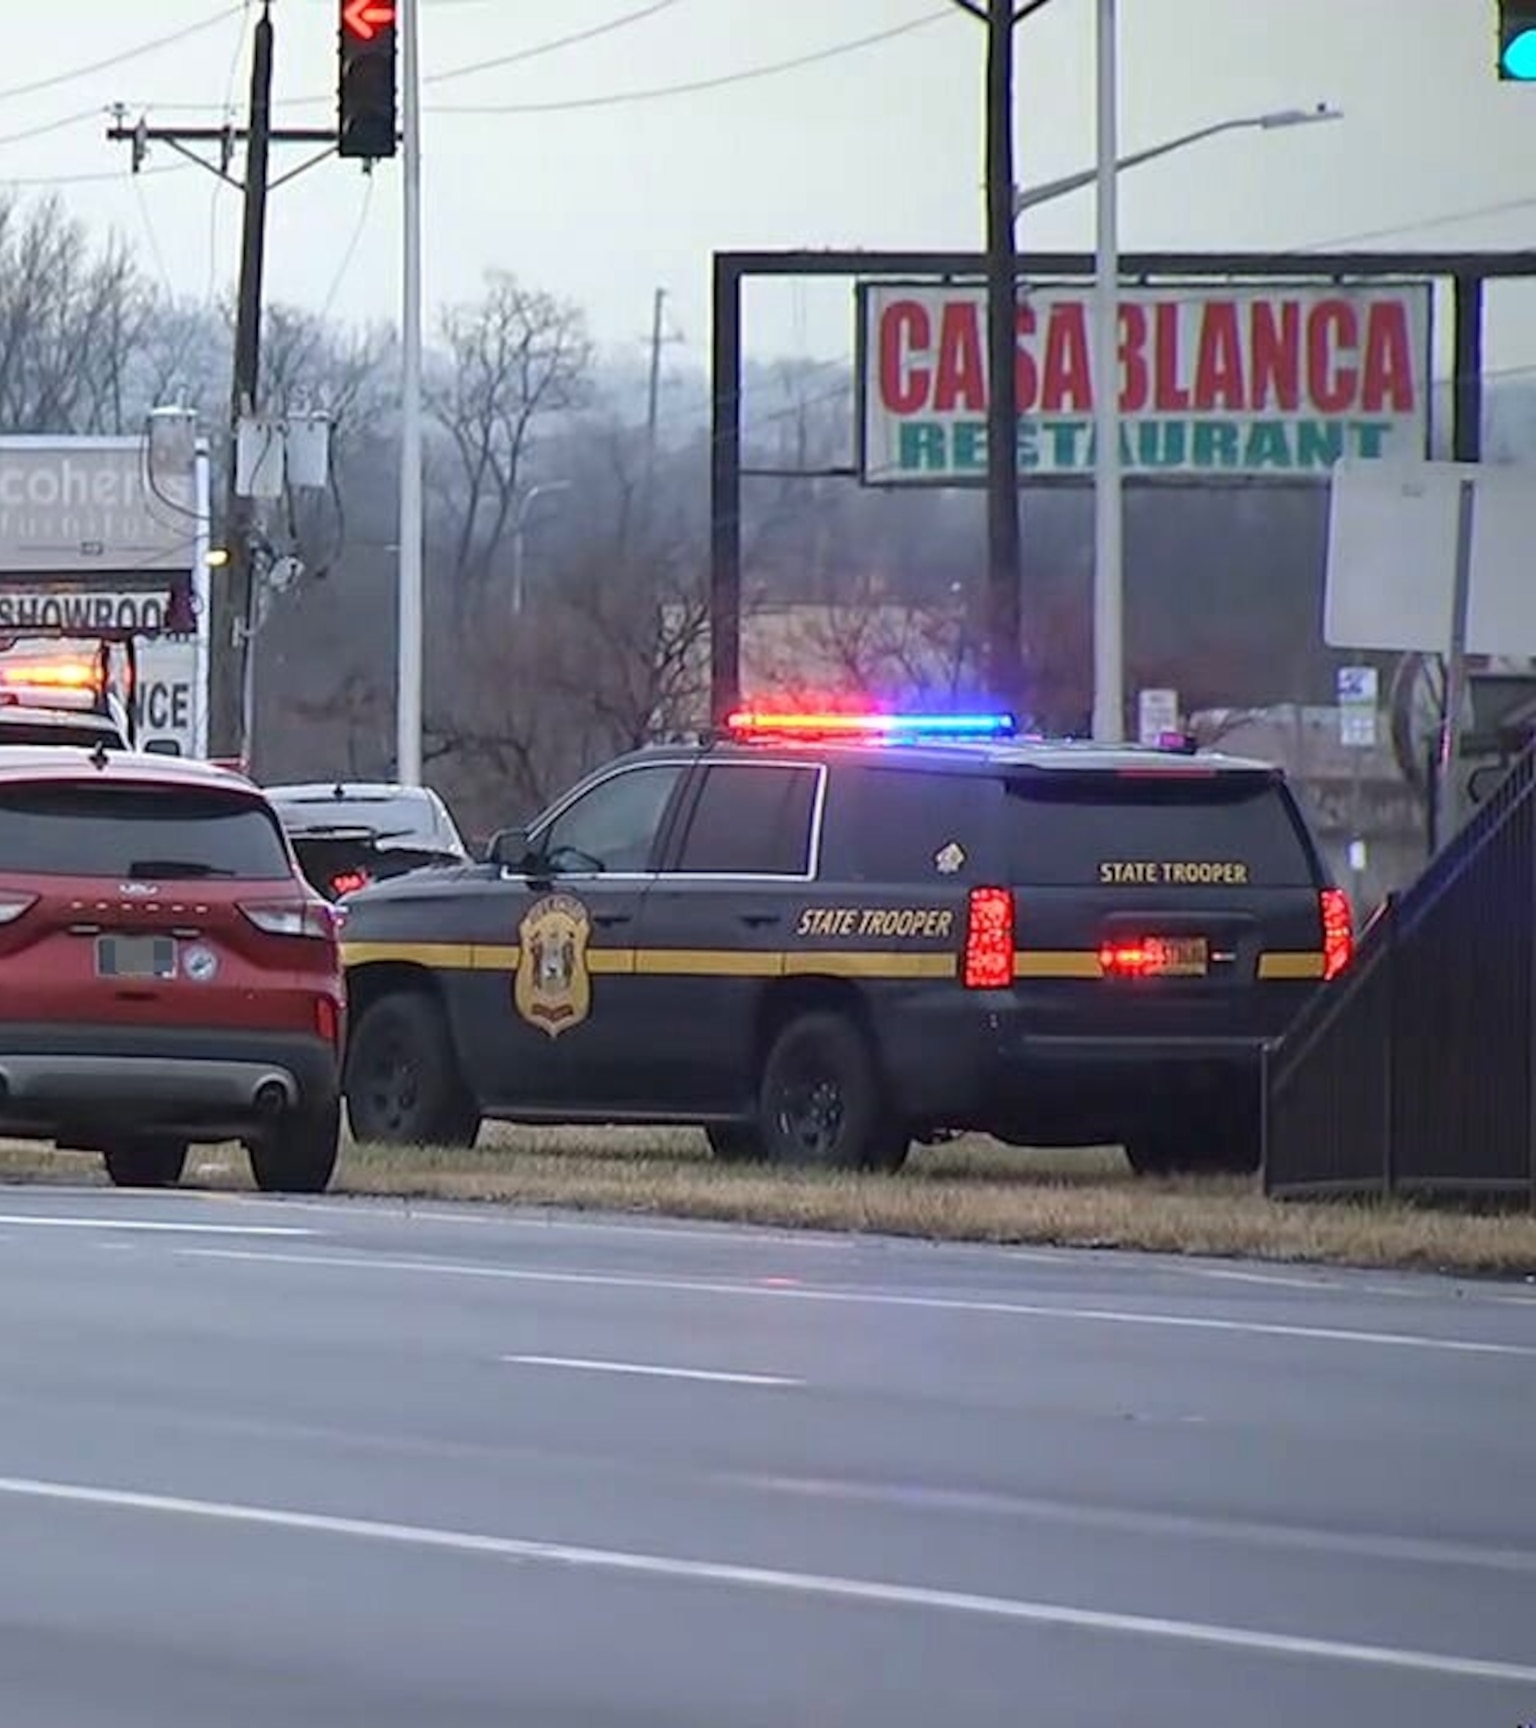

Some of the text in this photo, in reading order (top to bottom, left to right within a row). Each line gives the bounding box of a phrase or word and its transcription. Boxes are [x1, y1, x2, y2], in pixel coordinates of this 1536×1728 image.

[1100, 862, 1248, 884] STATE TROOPER
[797, 908, 953, 937] STATE TROOPER
